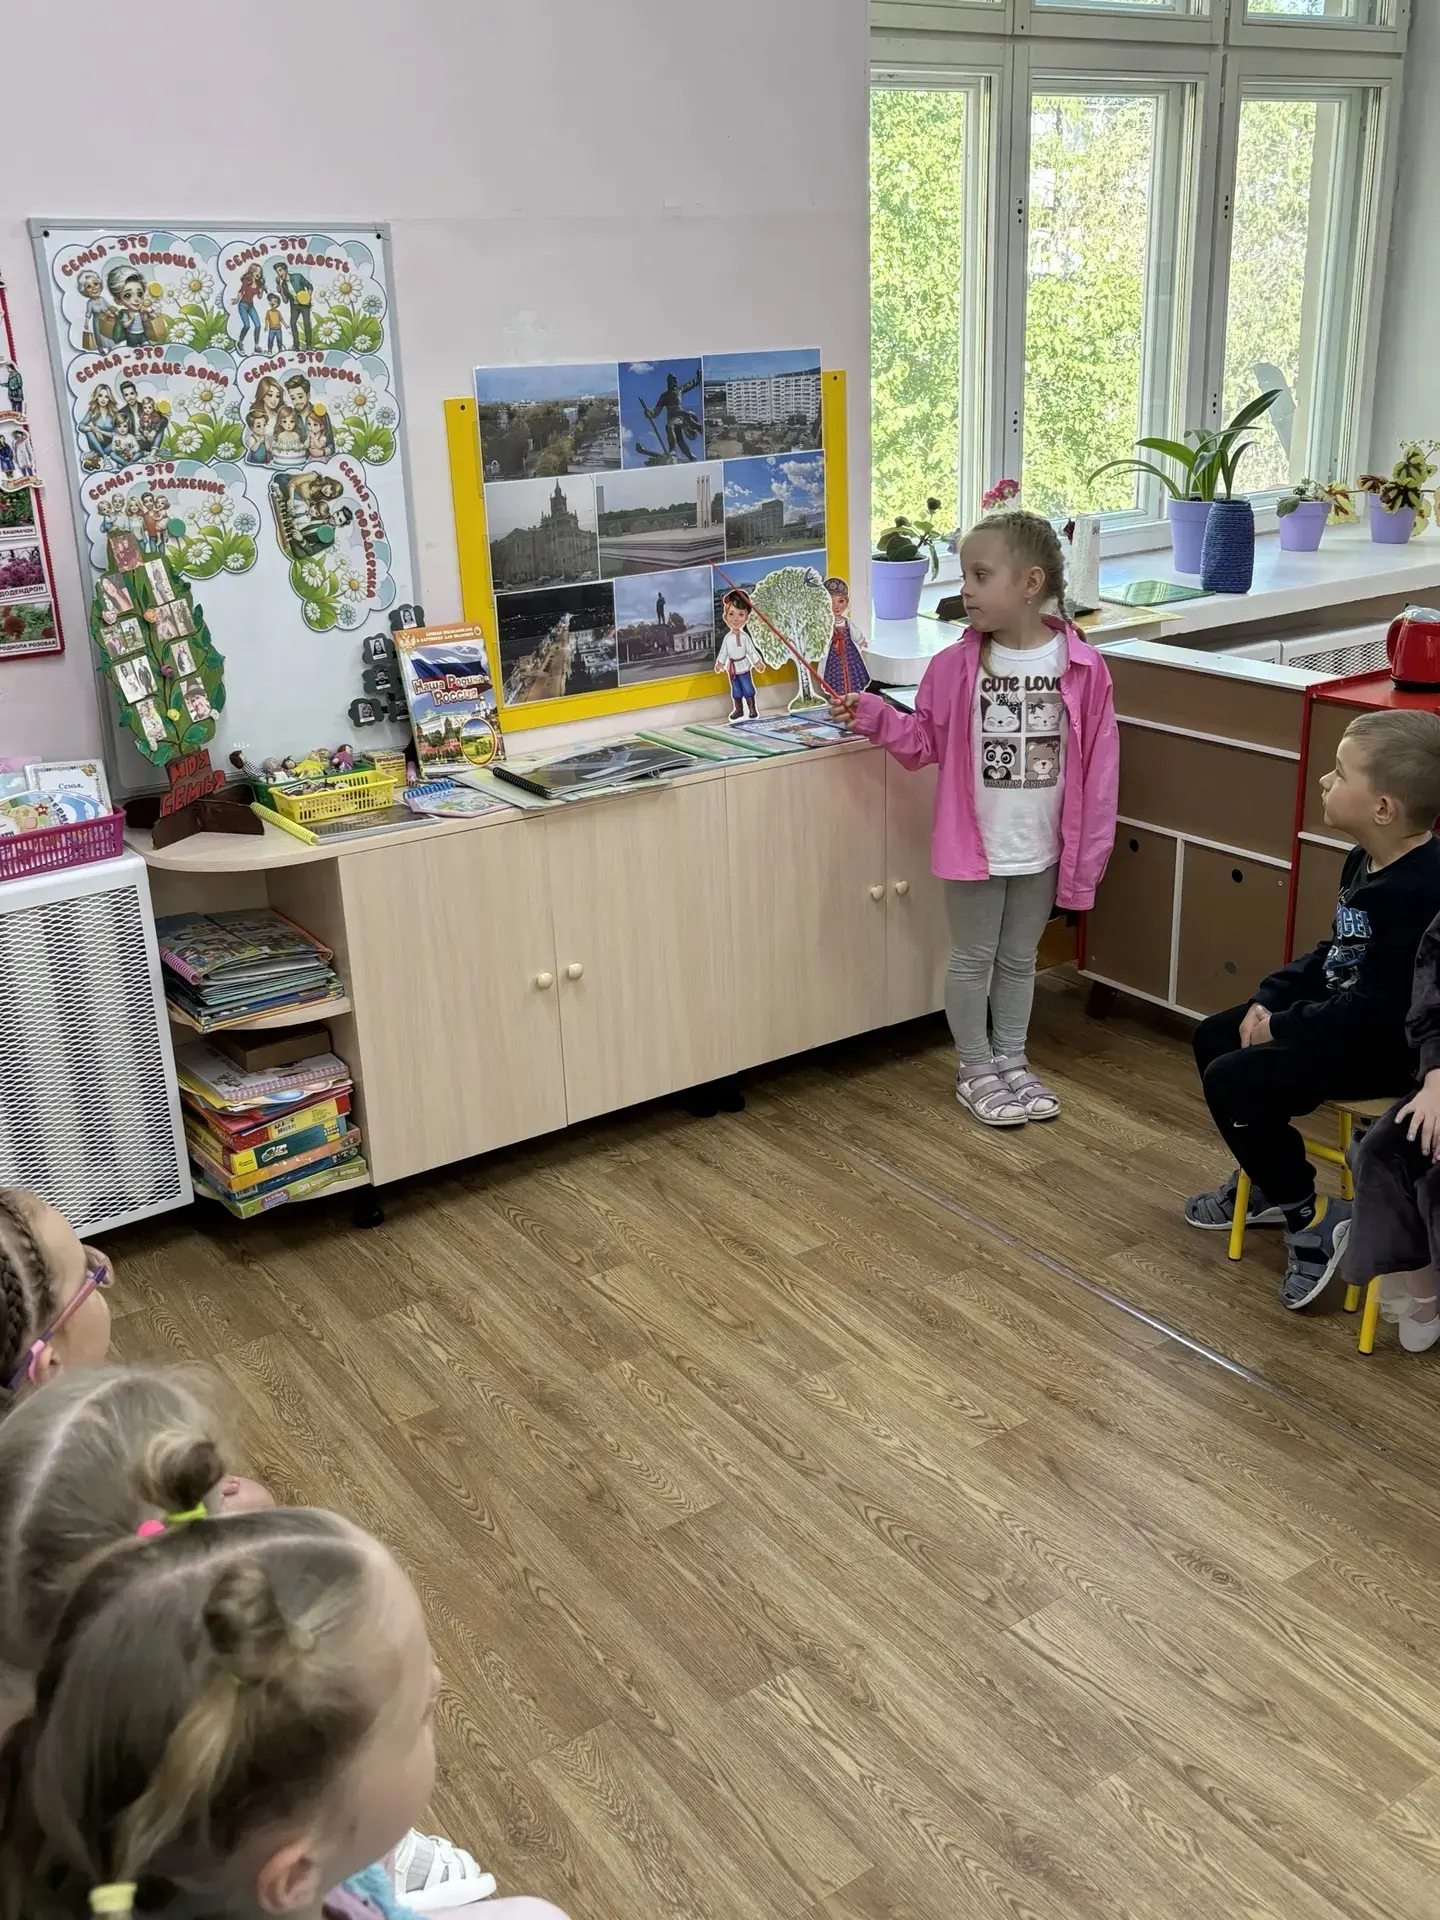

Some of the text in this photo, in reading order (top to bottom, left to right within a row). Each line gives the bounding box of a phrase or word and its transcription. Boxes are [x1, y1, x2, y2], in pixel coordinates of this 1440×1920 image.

[61, 245, 107, 277] СЕМЬЯ
[117, 235, 149, 251] ЭТО
[128, 252, 197, 269] ПОМОЩЬ
[225, 243, 269, 271] СЕМЬЯ
[278, 237, 308, 251] ЭТО
[286, 253, 350, 273] РАДОСТЬ
[75, 353, 122, 383] СЕМЬЯ
[133, 346, 164, 360] ЭТО
[122, 361, 229, 388] СЕРДЦЕ ДОМА
[243, 356, 287, 383] СЕМЬЯ
[296, 351, 325, 364] ЭТО
[307, 366, 362, 385] ЛЮБОВЬ
[88, 470, 134, 501] СЕМЬЯ
[144, 462, 175, 477] ЭТО
[147, 477, 226, 496] УВАЖЕНИЕ
[339, 460, 369, 502] СЕМЬЯ
[368, 511, 384, 540] ЭТО
[354, 508, 377, 598] ПОДДЕРЖКА
[28, 640, 56, 648] РОЗОВАЯ
[412, 679, 446, 695] Наша
[446, 674, 484, 689] Родина
[432, 688, 478, 706] Россия
[981, 676, 1020, 692] CUTE
[168, 748, 211, 785] МОЯ
[58, 782, 84, 790] Семья,
[161, 769, 226, 817] СЕМЬЯ
